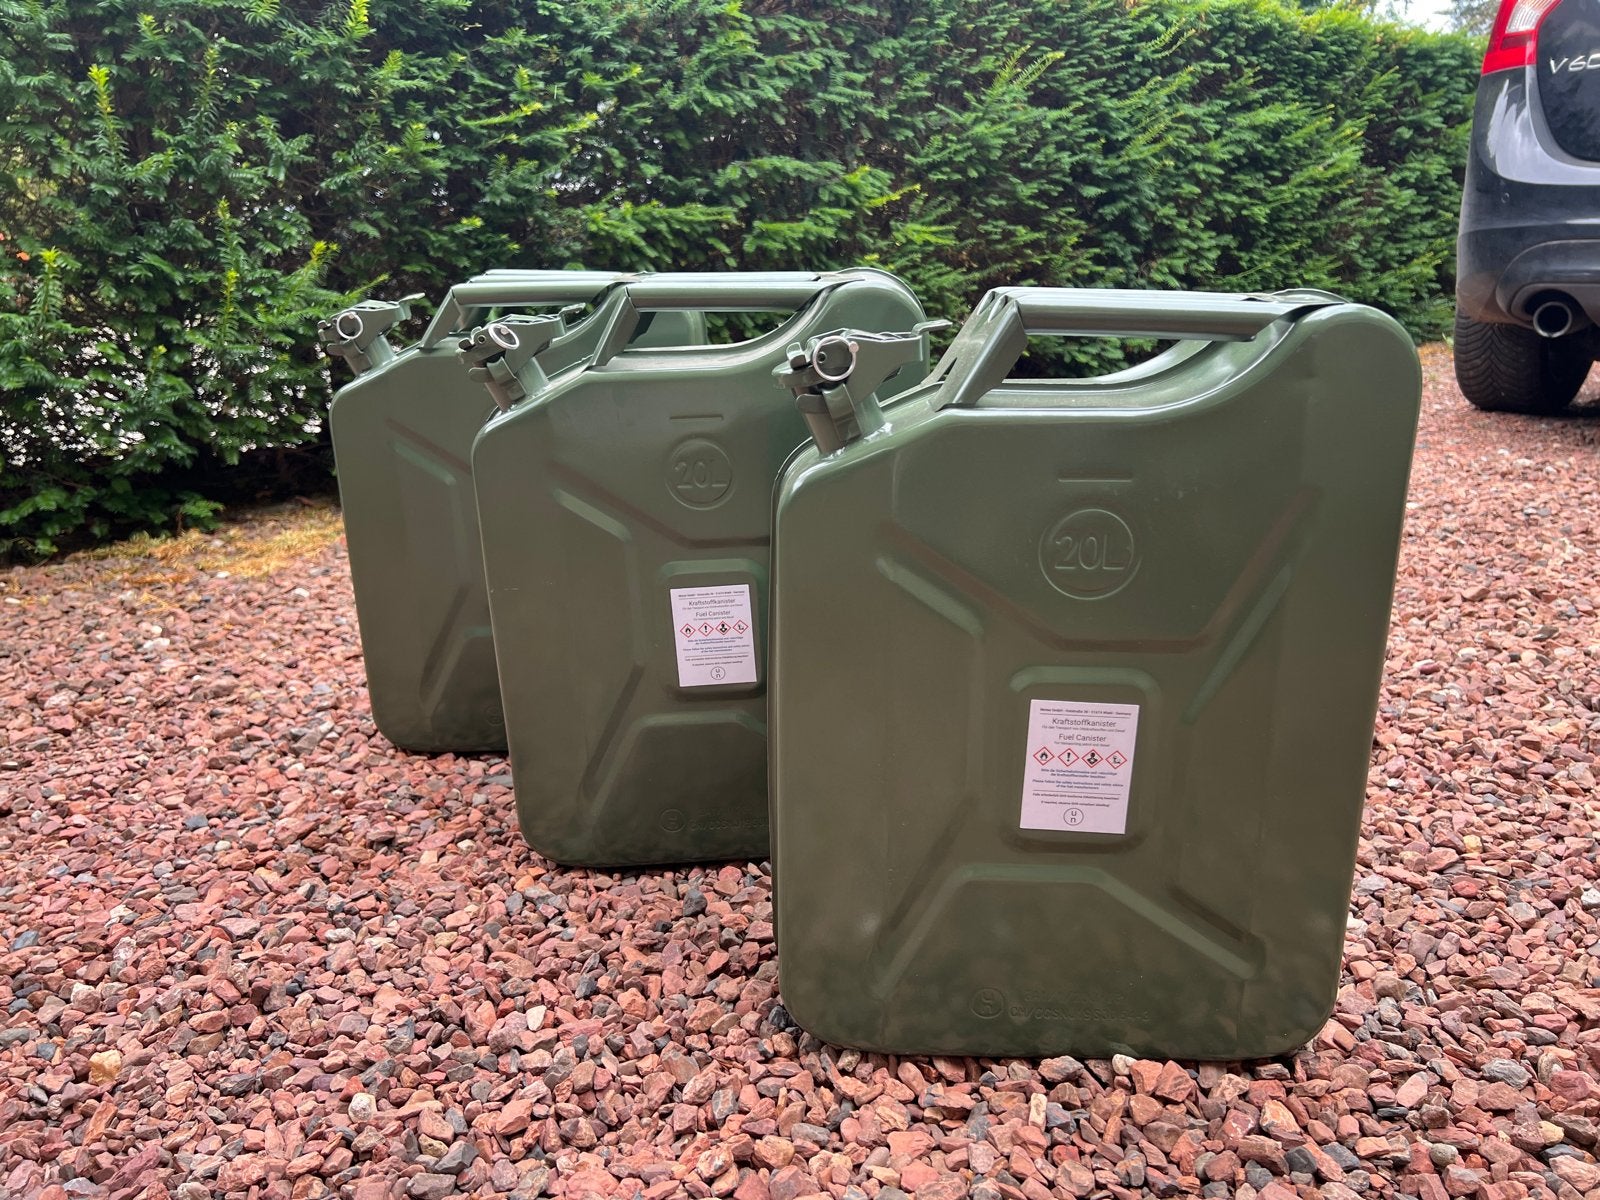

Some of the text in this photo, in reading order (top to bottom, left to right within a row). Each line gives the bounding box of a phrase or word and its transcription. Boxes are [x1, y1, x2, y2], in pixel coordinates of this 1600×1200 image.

[1549, 53, 1600, 75] V60
[673, 459, 728, 489] 20L
[1054, 534, 1126, 570] 20L
[689, 598, 736, 606] Kraftstoffkanister
[1052, 717, 1117, 727] Kraftstoffkanister
[1059, 733, 1106, 742] Fuel Canister
